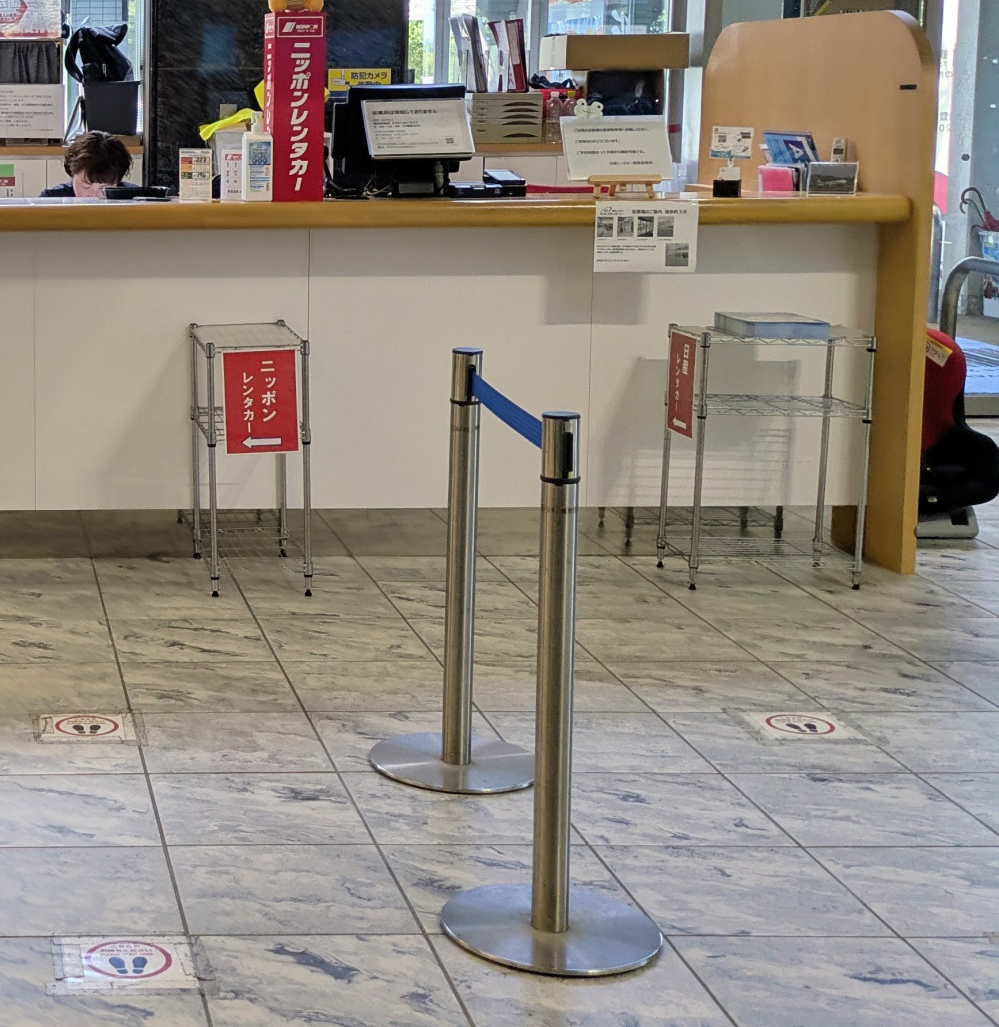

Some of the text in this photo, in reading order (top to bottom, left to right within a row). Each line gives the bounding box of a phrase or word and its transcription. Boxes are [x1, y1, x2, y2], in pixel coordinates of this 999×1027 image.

[351, 71, 387, 80] 防犯カメラ
[289, 42, 312, 191] ニッポンレンタカー
[242, 372, 255, 433] レンタカー
[260, 360, 277, 423] ニッポン
